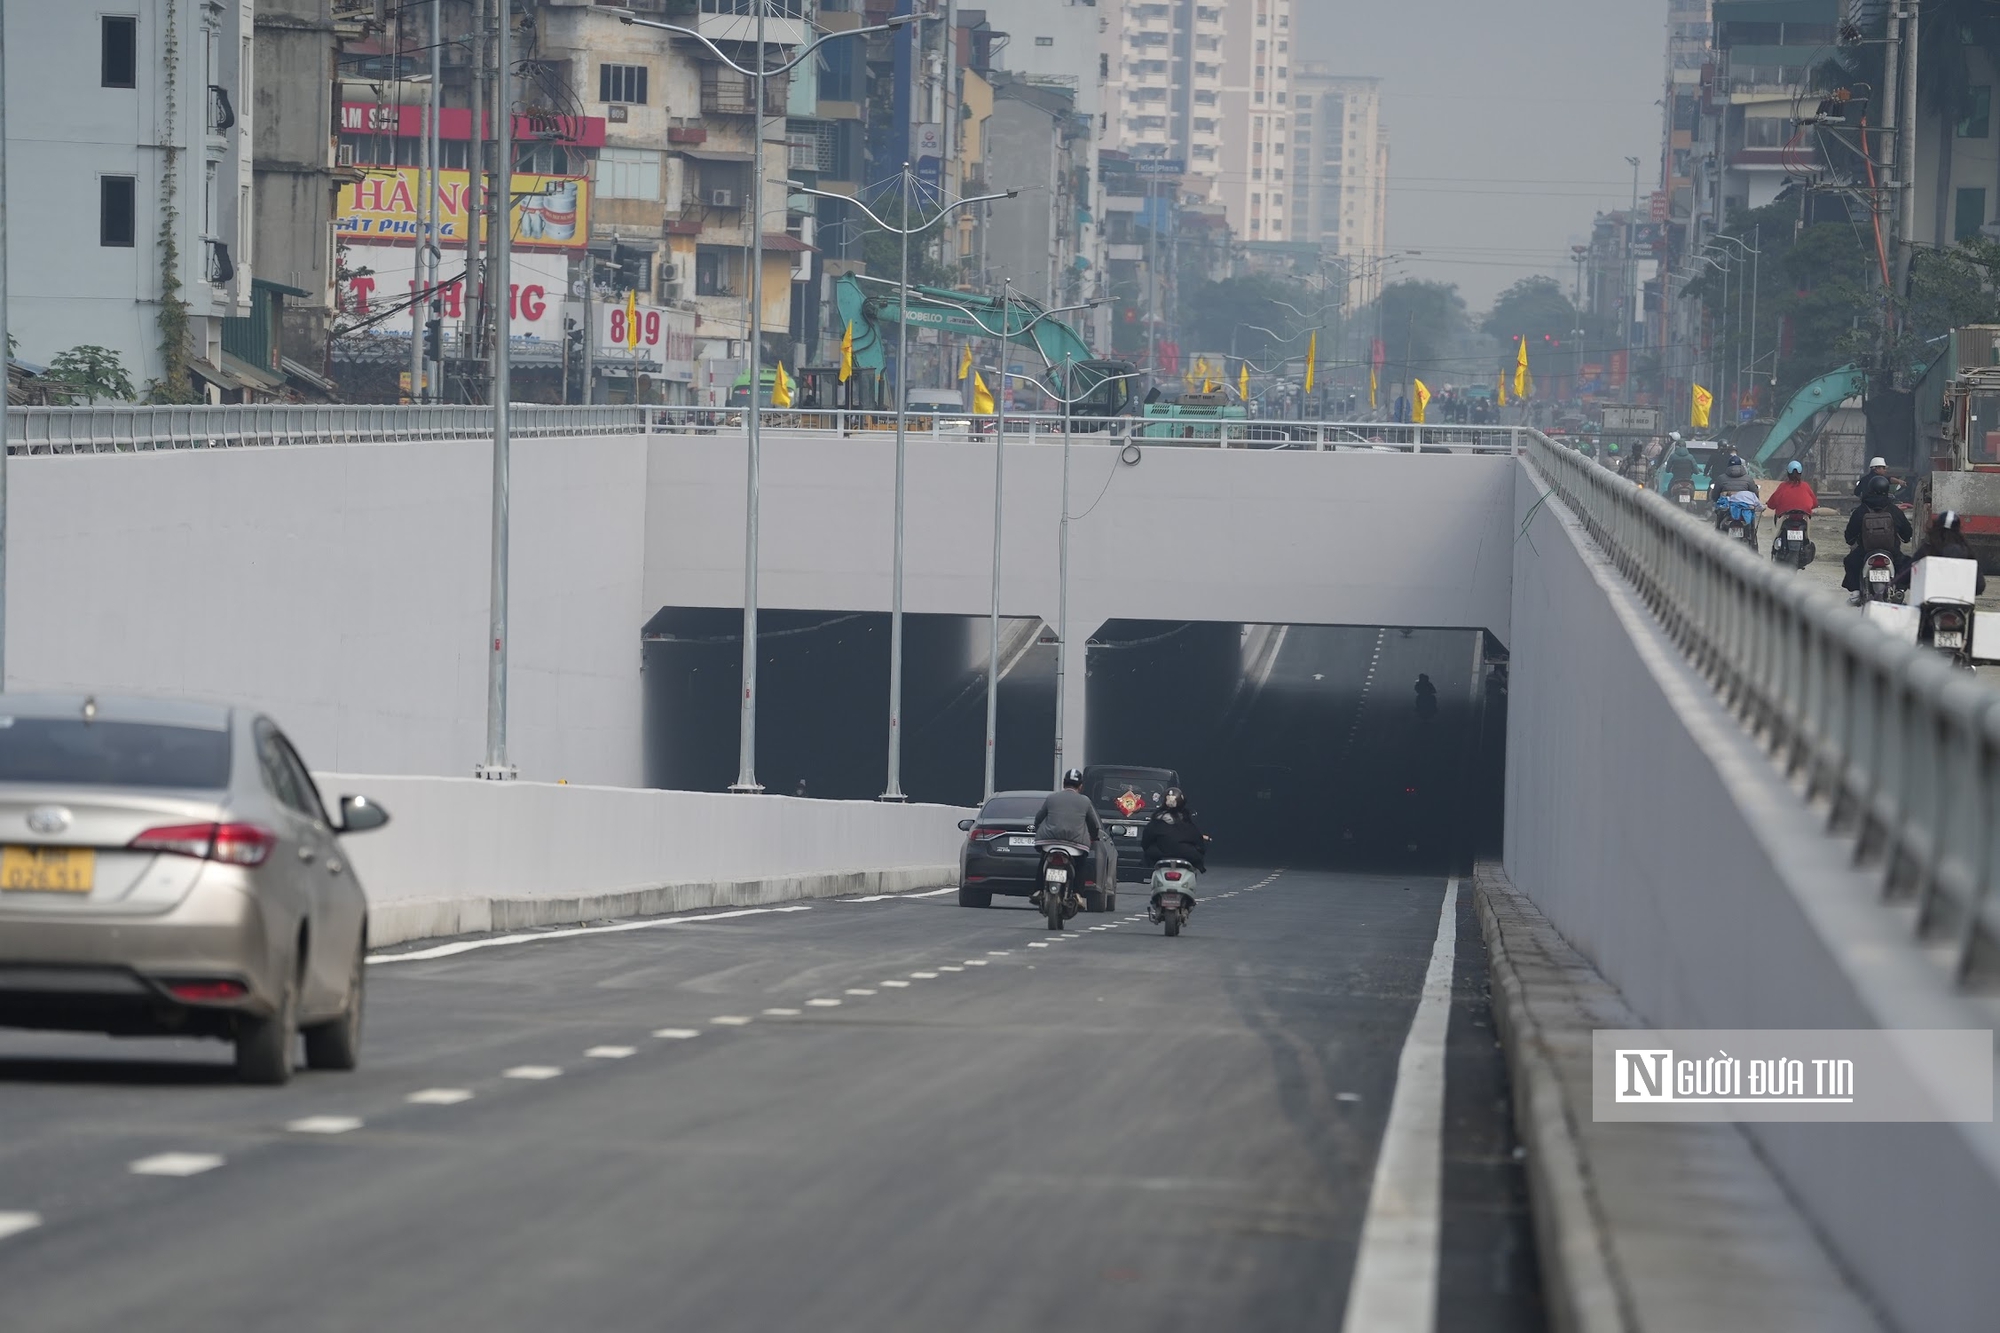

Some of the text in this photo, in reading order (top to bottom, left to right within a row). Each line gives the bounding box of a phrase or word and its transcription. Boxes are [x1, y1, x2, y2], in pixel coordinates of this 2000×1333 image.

[1140, 163, 1156, 172] Kid
[351, 171, 416, 213] HÀ
[408, 280, 546, 322] PHG
[905, 310, 943, 323] KOBELCO
